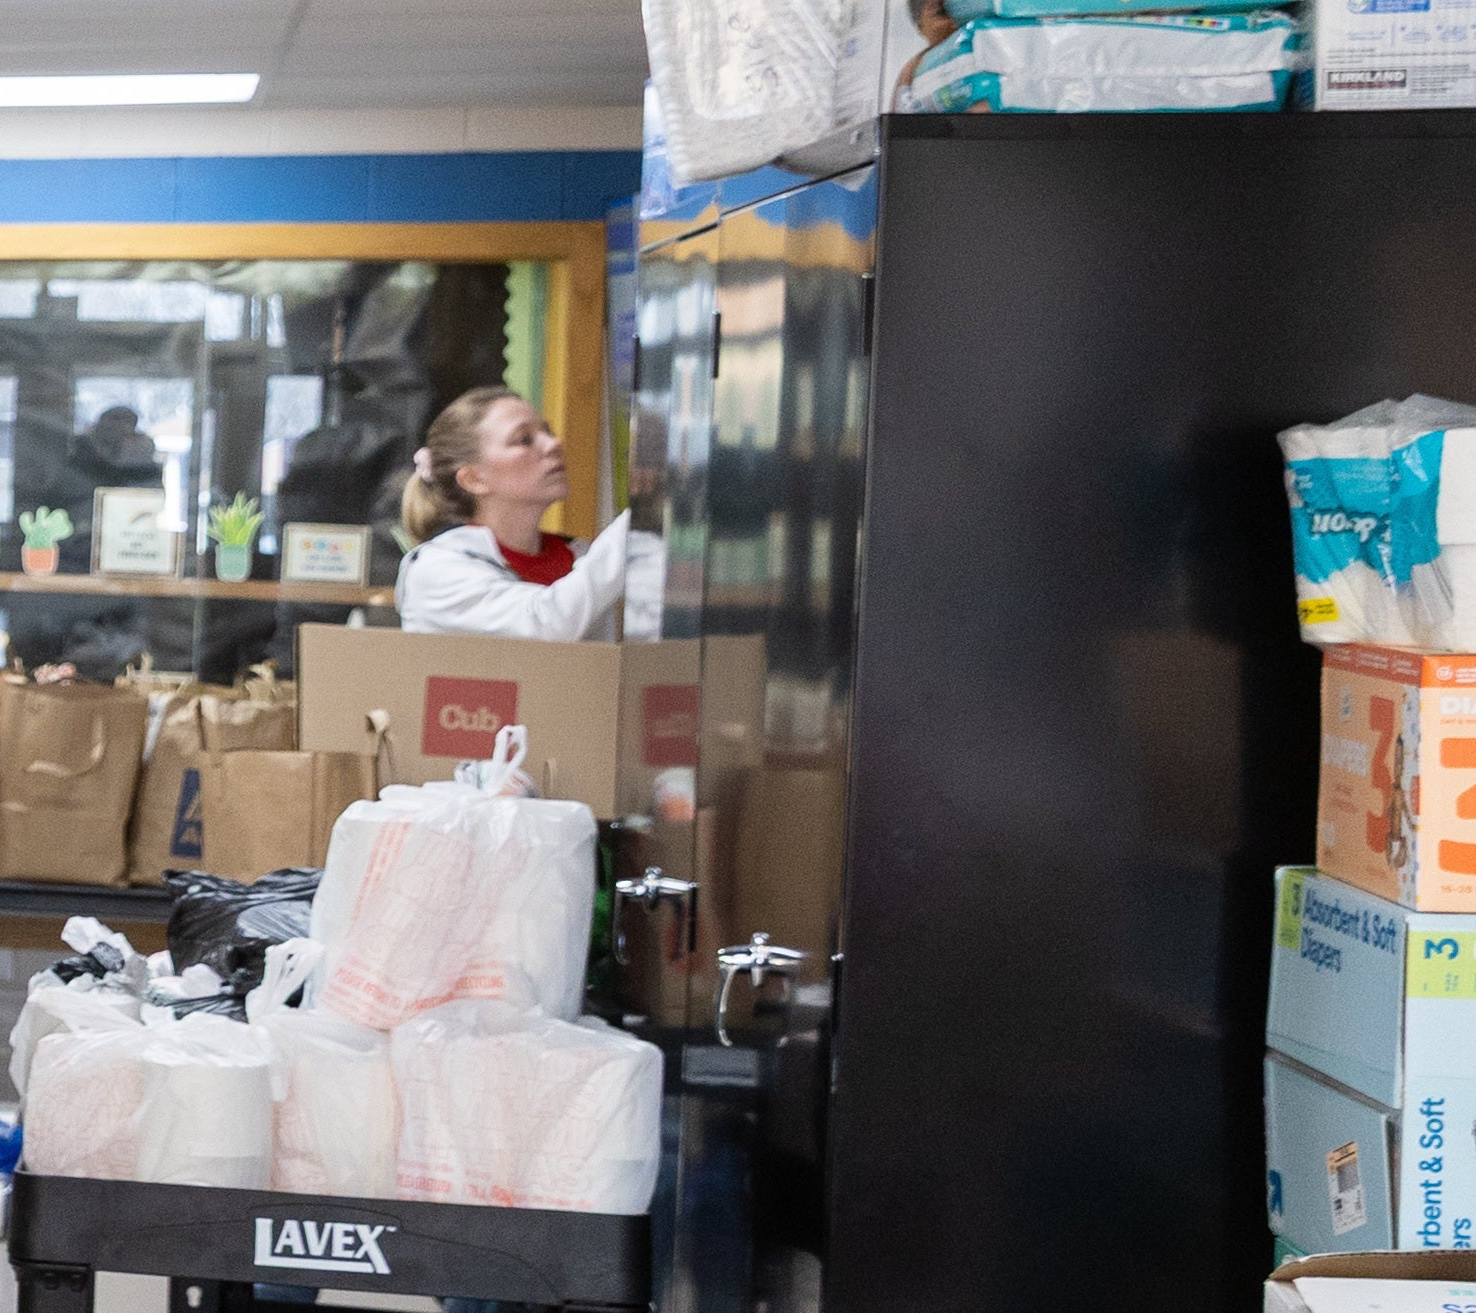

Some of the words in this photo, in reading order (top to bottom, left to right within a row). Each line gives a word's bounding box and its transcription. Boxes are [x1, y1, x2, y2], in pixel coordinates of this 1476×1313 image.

[1329, 70, 1405, 84] KIRKLAND
[436, 701, 498, 734] Cub
[1302, 888, 1362, 941] Absorbent
[1372, 916, 1399, 957] Soft
[1299, 927, 1343, 975] Diapers
[1424, 936, 1460, 961] 3
[1417, 1096, 1447, 1152] Soft
[1420, 1157, 1444, 1175] &
[253, 1217, 393, 1276] LAVEX
